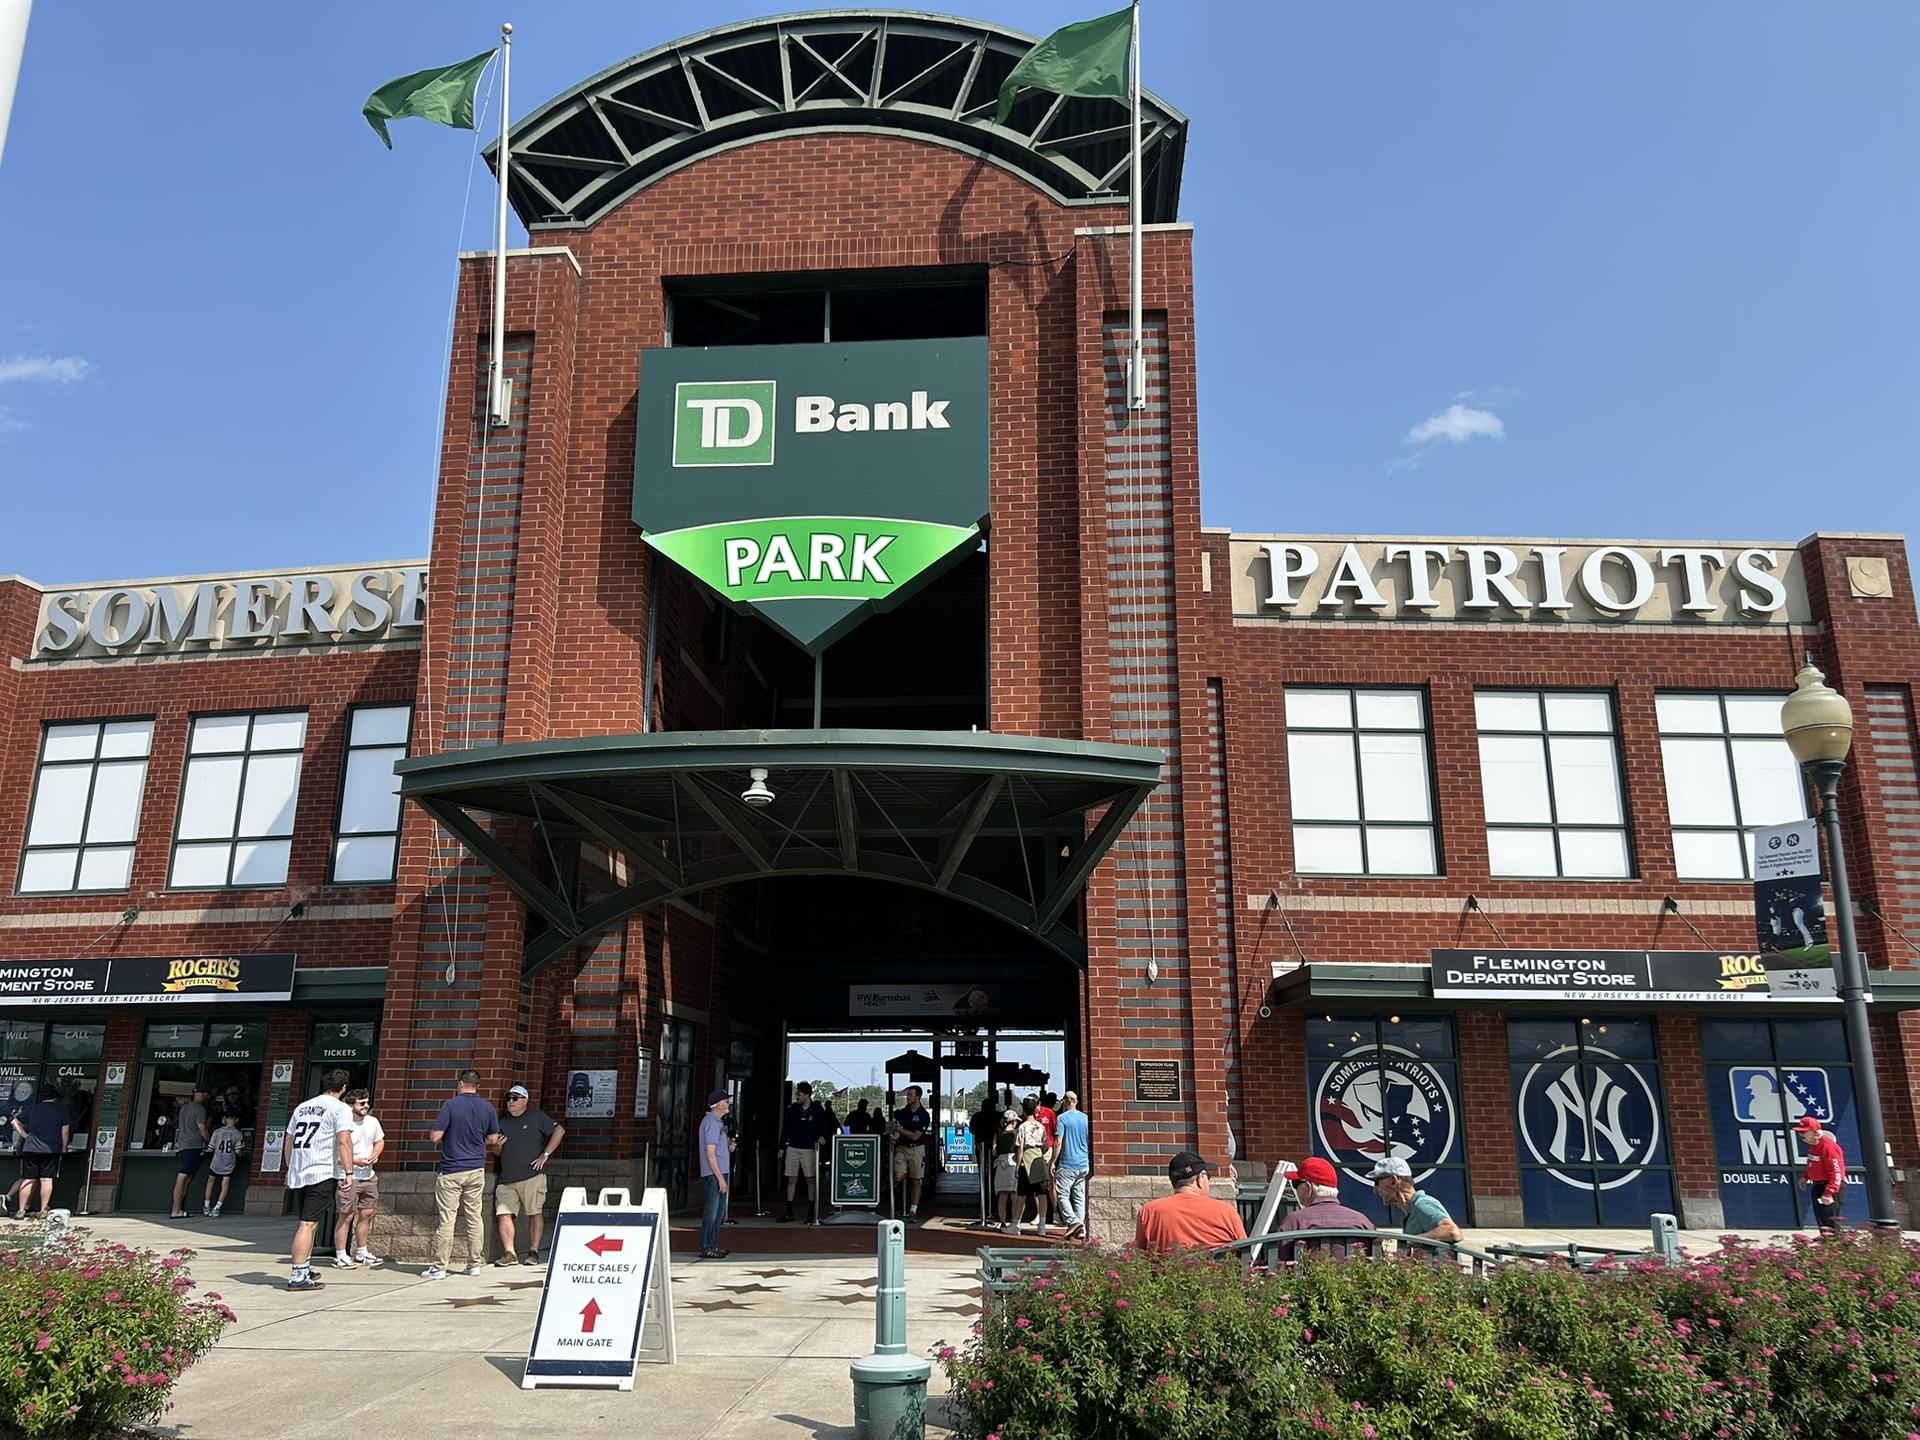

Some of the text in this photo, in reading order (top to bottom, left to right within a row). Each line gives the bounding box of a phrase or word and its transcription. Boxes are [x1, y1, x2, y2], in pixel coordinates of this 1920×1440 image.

[687, 391, 951, 449] TD Bank
[724, 533, 899, 587] PARK
[1259, 541, 1788, 614] PATRIOTS
[167, 957, 240, 980] ROGER'S
[1473, 956, 1606, 971] FLEMINGTON
[1446, 970, 1636, 986] DEPARTMENT STORE
[0, 978, 95, 992] MENT STORE
[54, 996, 95, 1004] JERSEY'S
[98, 995, 120, 1003] BEST
[1564, 991, 1586, 999] NEW
[1590, 991, 1640, 1000] JERSEY'S
[1645, 992, 1671, 1000] BEST
[6, 1031, 29, 1040] WILL
[64, 1030, 89, 1040] CALL
[170, 1025, 180, 1040] 1
[233, 1025, 245, 1039] 2
[338, 1023, 349, 1038] 3
[154, 1050, 186, 1059] TICKETS
[217, 1050, 250, 1058] TICKETS
[323, 1048, 357, 1057] TICKETS
[0, 1066, 24, 1076] WILL
[58, 1066, 85, 1076] CALL
[293, 1121, 321, 1149] 27
[218, 1139, 233, 1154] 48
[1738, 1129, 1837, 1165] MiL
[1723, 1173, 1771, 1184] DOUBLE
[1779, 1174, 1789, 1185] A
[562, 1263, 637, 1275] TICKET SALES /
[572, 1276, 623, 1285] WILL CALL
[557, 1338, 613, 1348] MAIN GATE
